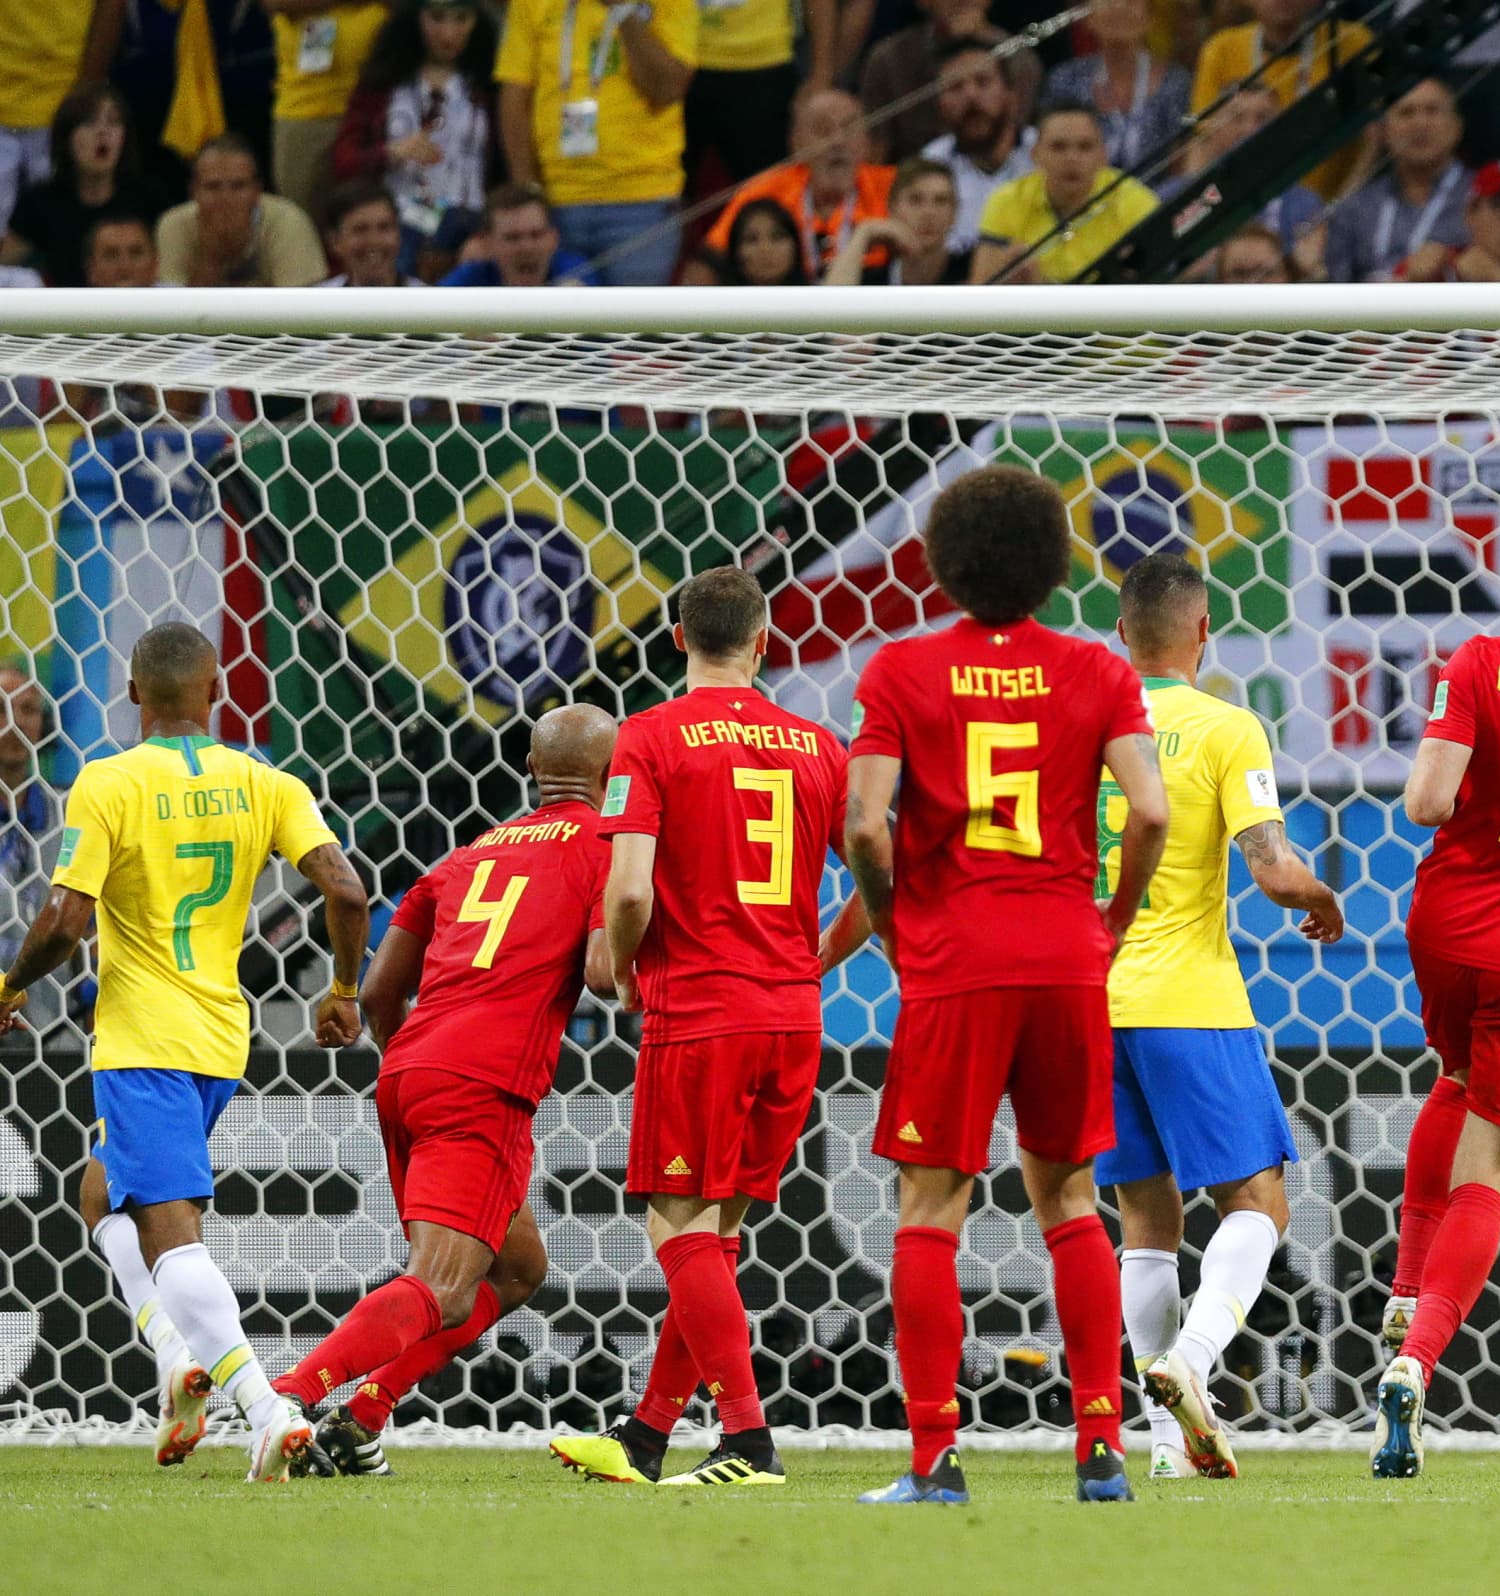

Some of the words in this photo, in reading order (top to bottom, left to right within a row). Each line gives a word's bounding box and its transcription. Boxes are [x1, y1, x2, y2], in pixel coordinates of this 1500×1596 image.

[950, 665, 1051, 700] WITSEL
[680, 720, 819, 758] VERMAELEN
[965, 721, 1043, 858] 6
[156, 793, 176, 821] D.
[185, 786, 250, 818] COSTA
[732, 767, 794, 906] 3
[171, 840, 235, 972] 7
[456, 859, 530, 970] 4
